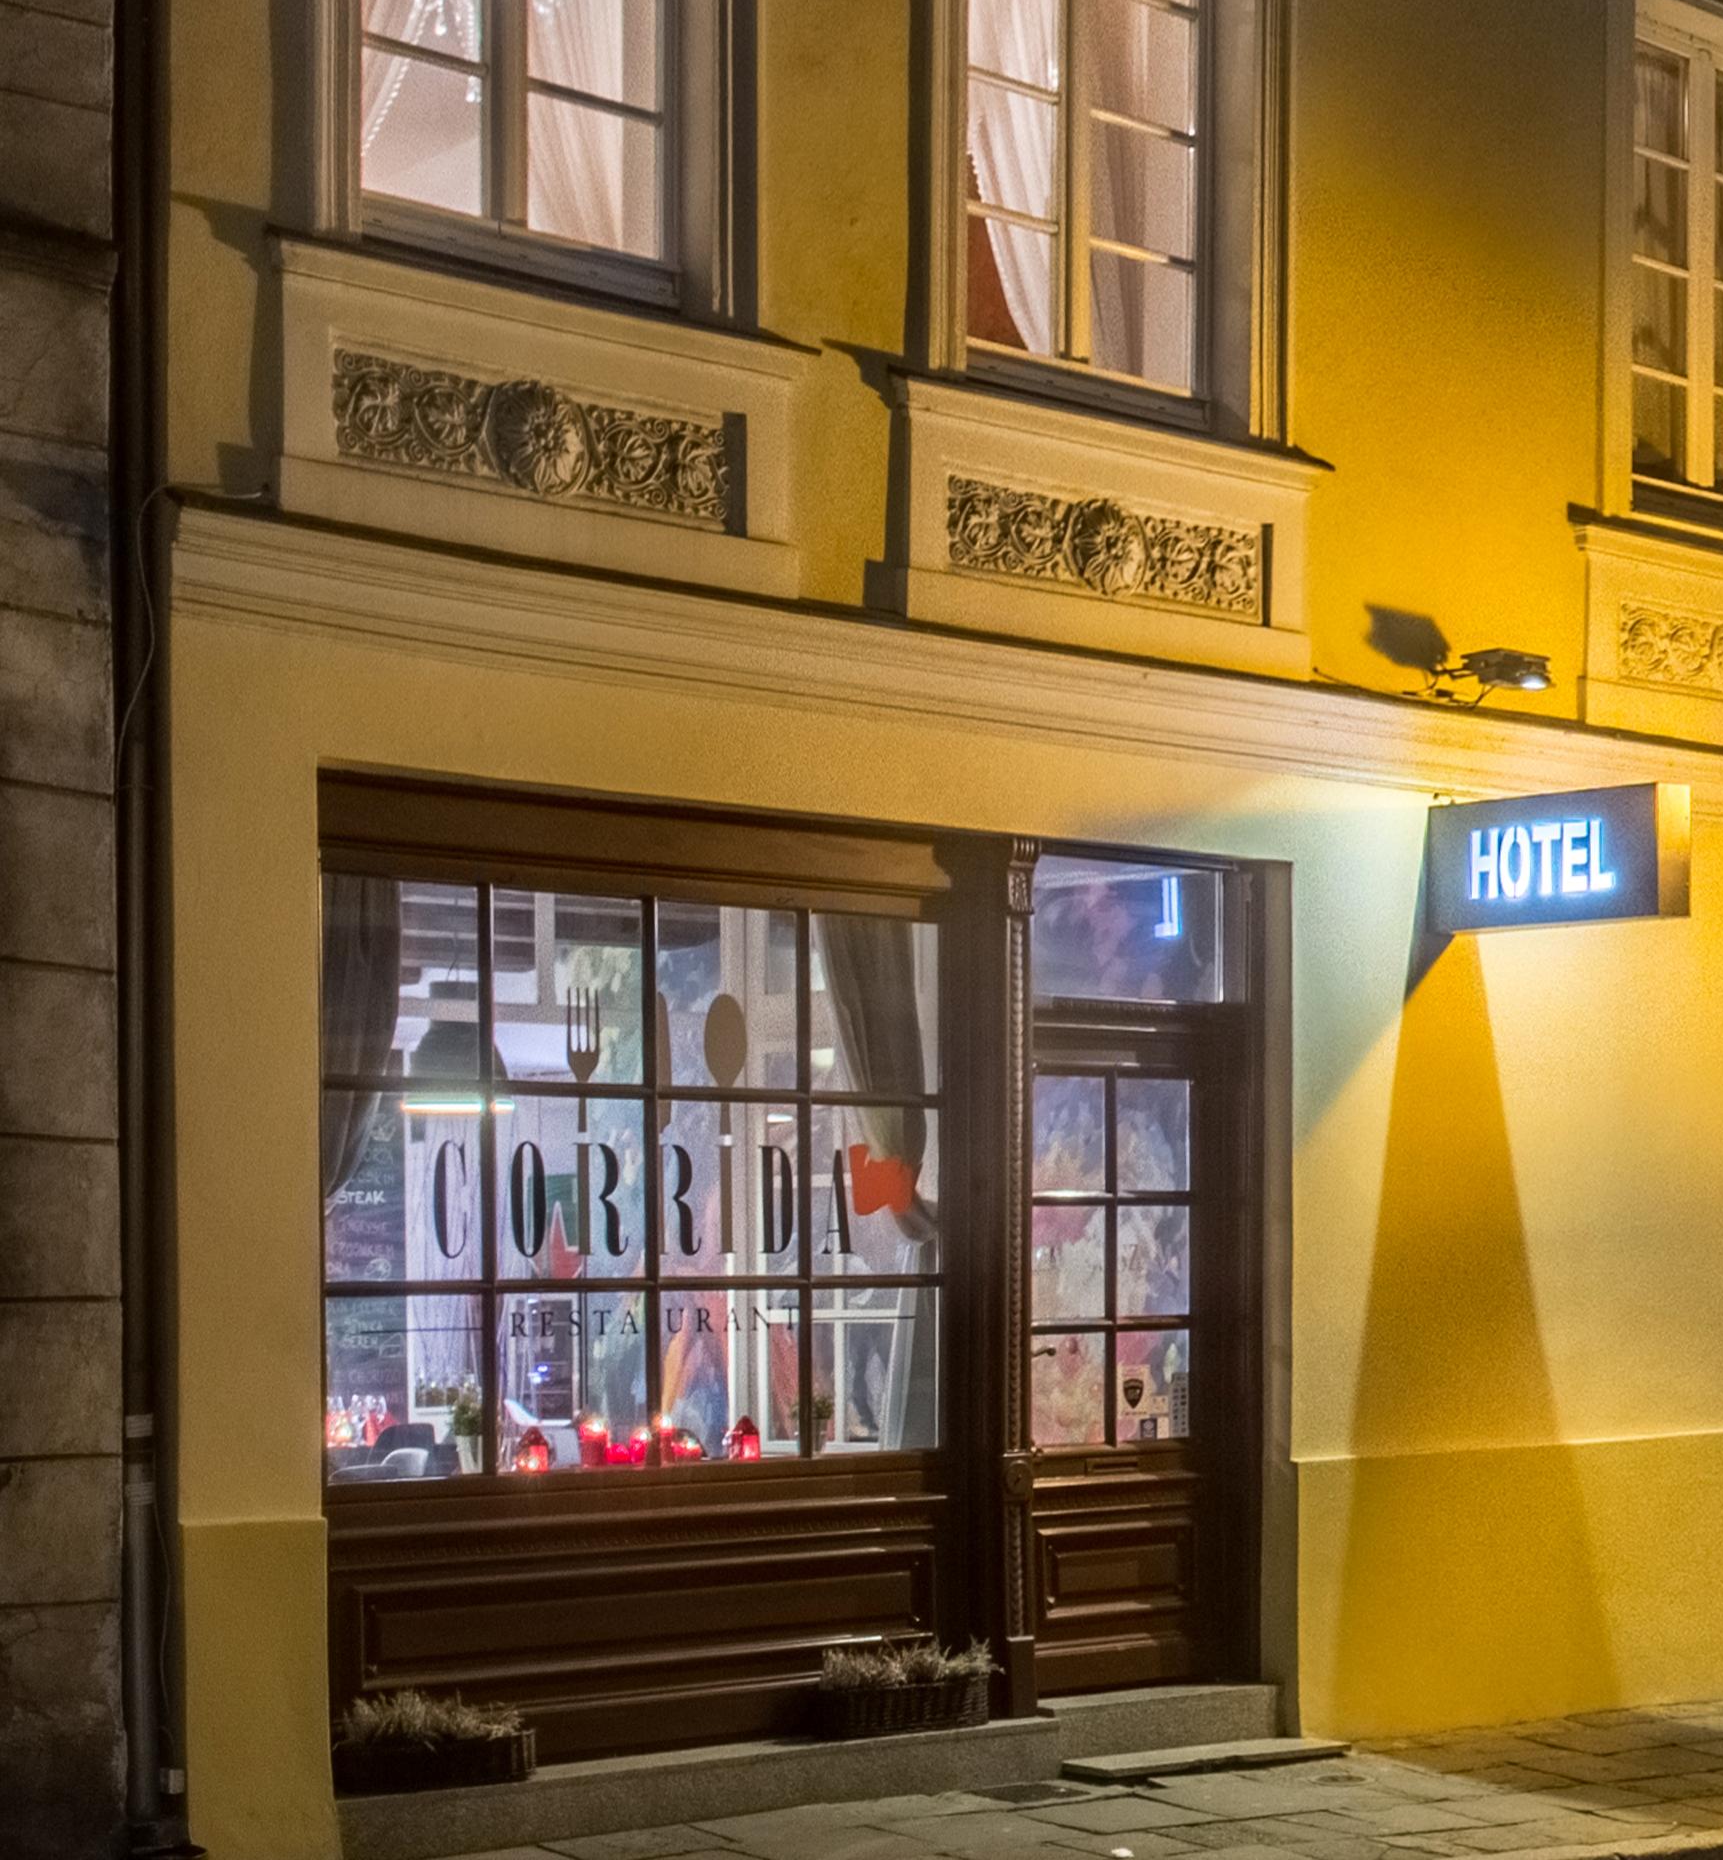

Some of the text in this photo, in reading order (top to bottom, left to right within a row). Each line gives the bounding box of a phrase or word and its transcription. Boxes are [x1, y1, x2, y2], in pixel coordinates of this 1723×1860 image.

[1470, 819, 1616, 900] HOTEL
[335, 1189, 387, 1205] STEAK
[433, 1138, 854, 1259] CORRIDA
[510, 1304, 801, 1337] RESTAURANT
